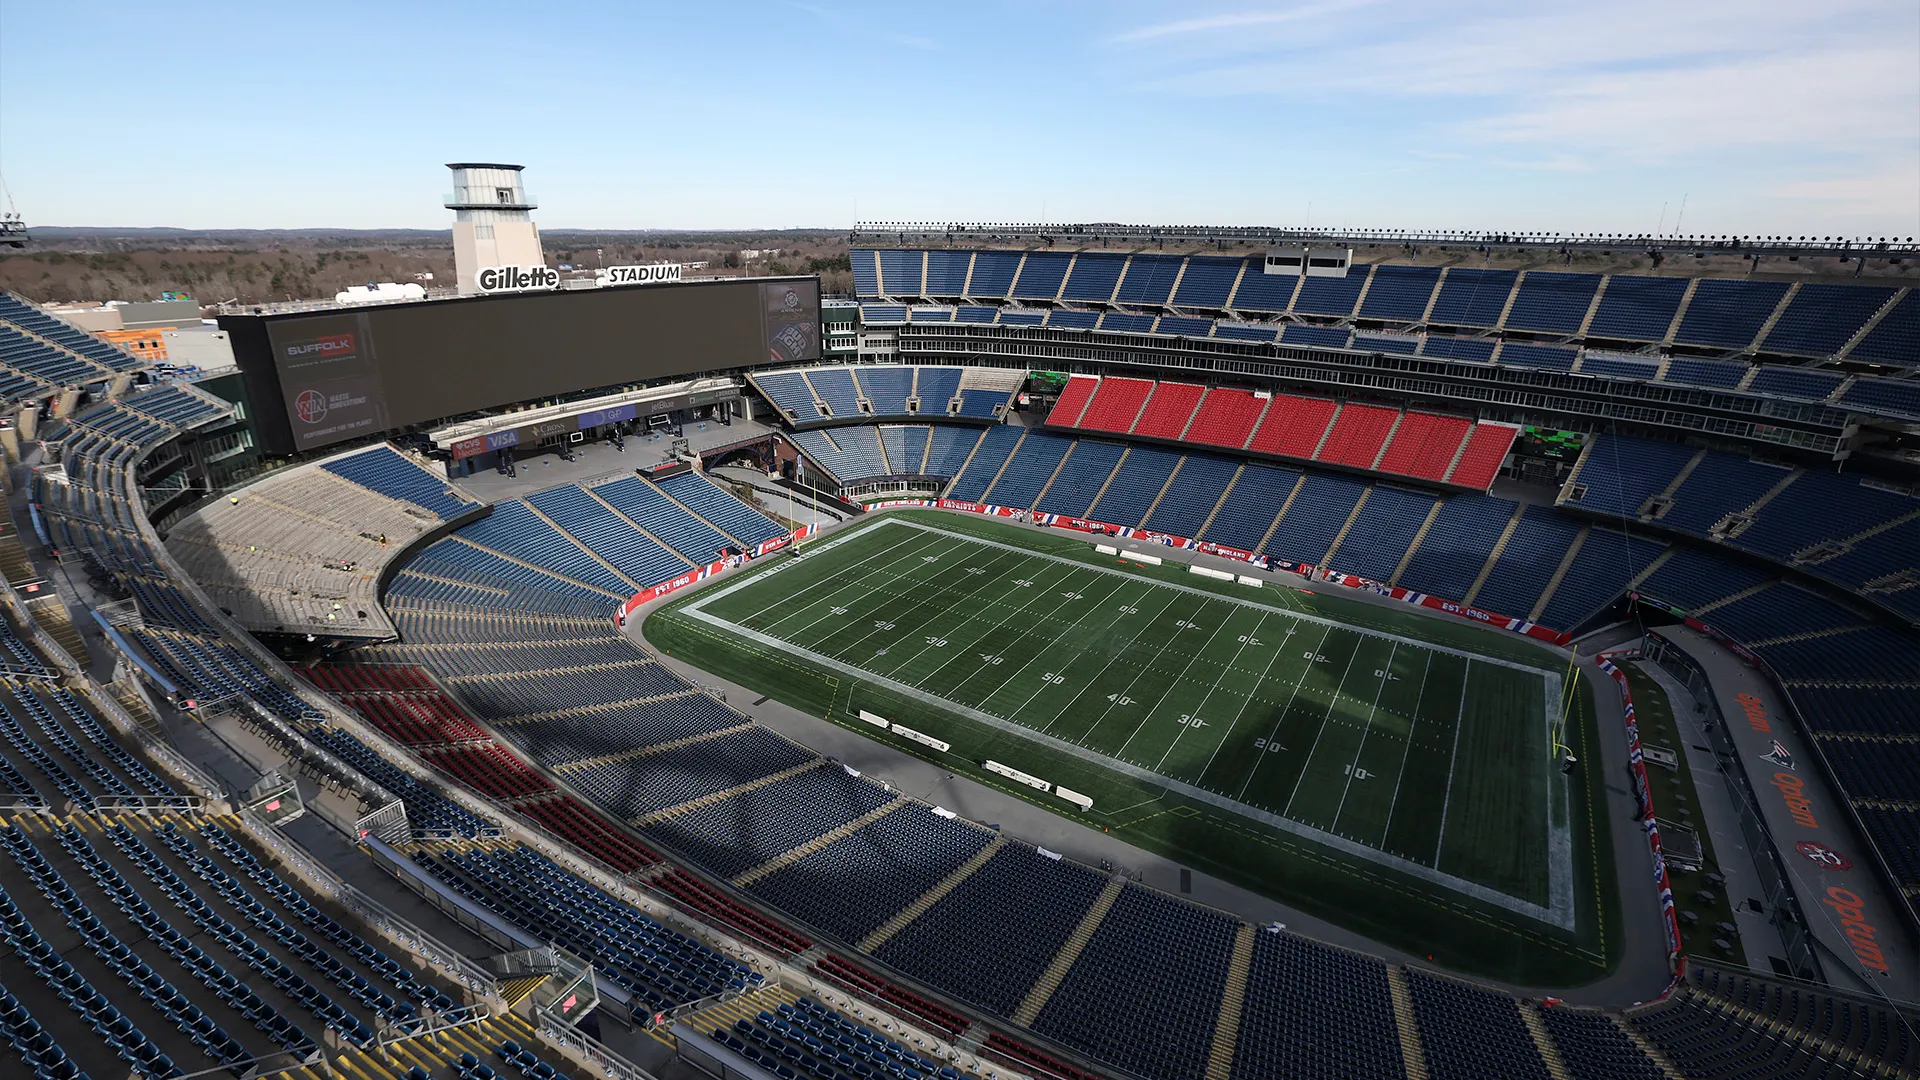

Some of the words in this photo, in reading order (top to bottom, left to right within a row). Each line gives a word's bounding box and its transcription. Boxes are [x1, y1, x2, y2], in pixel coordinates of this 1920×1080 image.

[481, 267, 557, 290] Gillette
[609, 266, 680, 283] STADIUM
[786, 326, 807, 350] BUD
[288, 339, 350, 355] SUFFOLK
[301, 399, 324, 414] WIN
[463, 438, 480, 449] CVS
[488, 432, 516, 447] VISA
[943, 501, 977, 512] PATRIOTS
[673, 576, 690, 588] 1960
[1118, 605, 1139, 614] 50
[1442, 602, 1463, 614] EST.
[1466, 608, 1490, 621] 1960
[875, 620, 896, 630] 20
[926, 635, 948, 647] 30
[982, 655, 1004, 665] 40
[1303, 651, 1325, 663] 20
[1041, 672, 1065, 685] 50
[1374, 669, 1393, 680] 10
[1107, 693, 1131, 706] 40
[1735, 692, 1771, 733] Optum
[1177, 714, 1203, 728] 30
[1254, 737, 1282, 753] 20
[1344, 764, 1368, 780] 10
[1771, 772, 1818, 828] Optum
[1823, 887, 1888, 970] Optum
